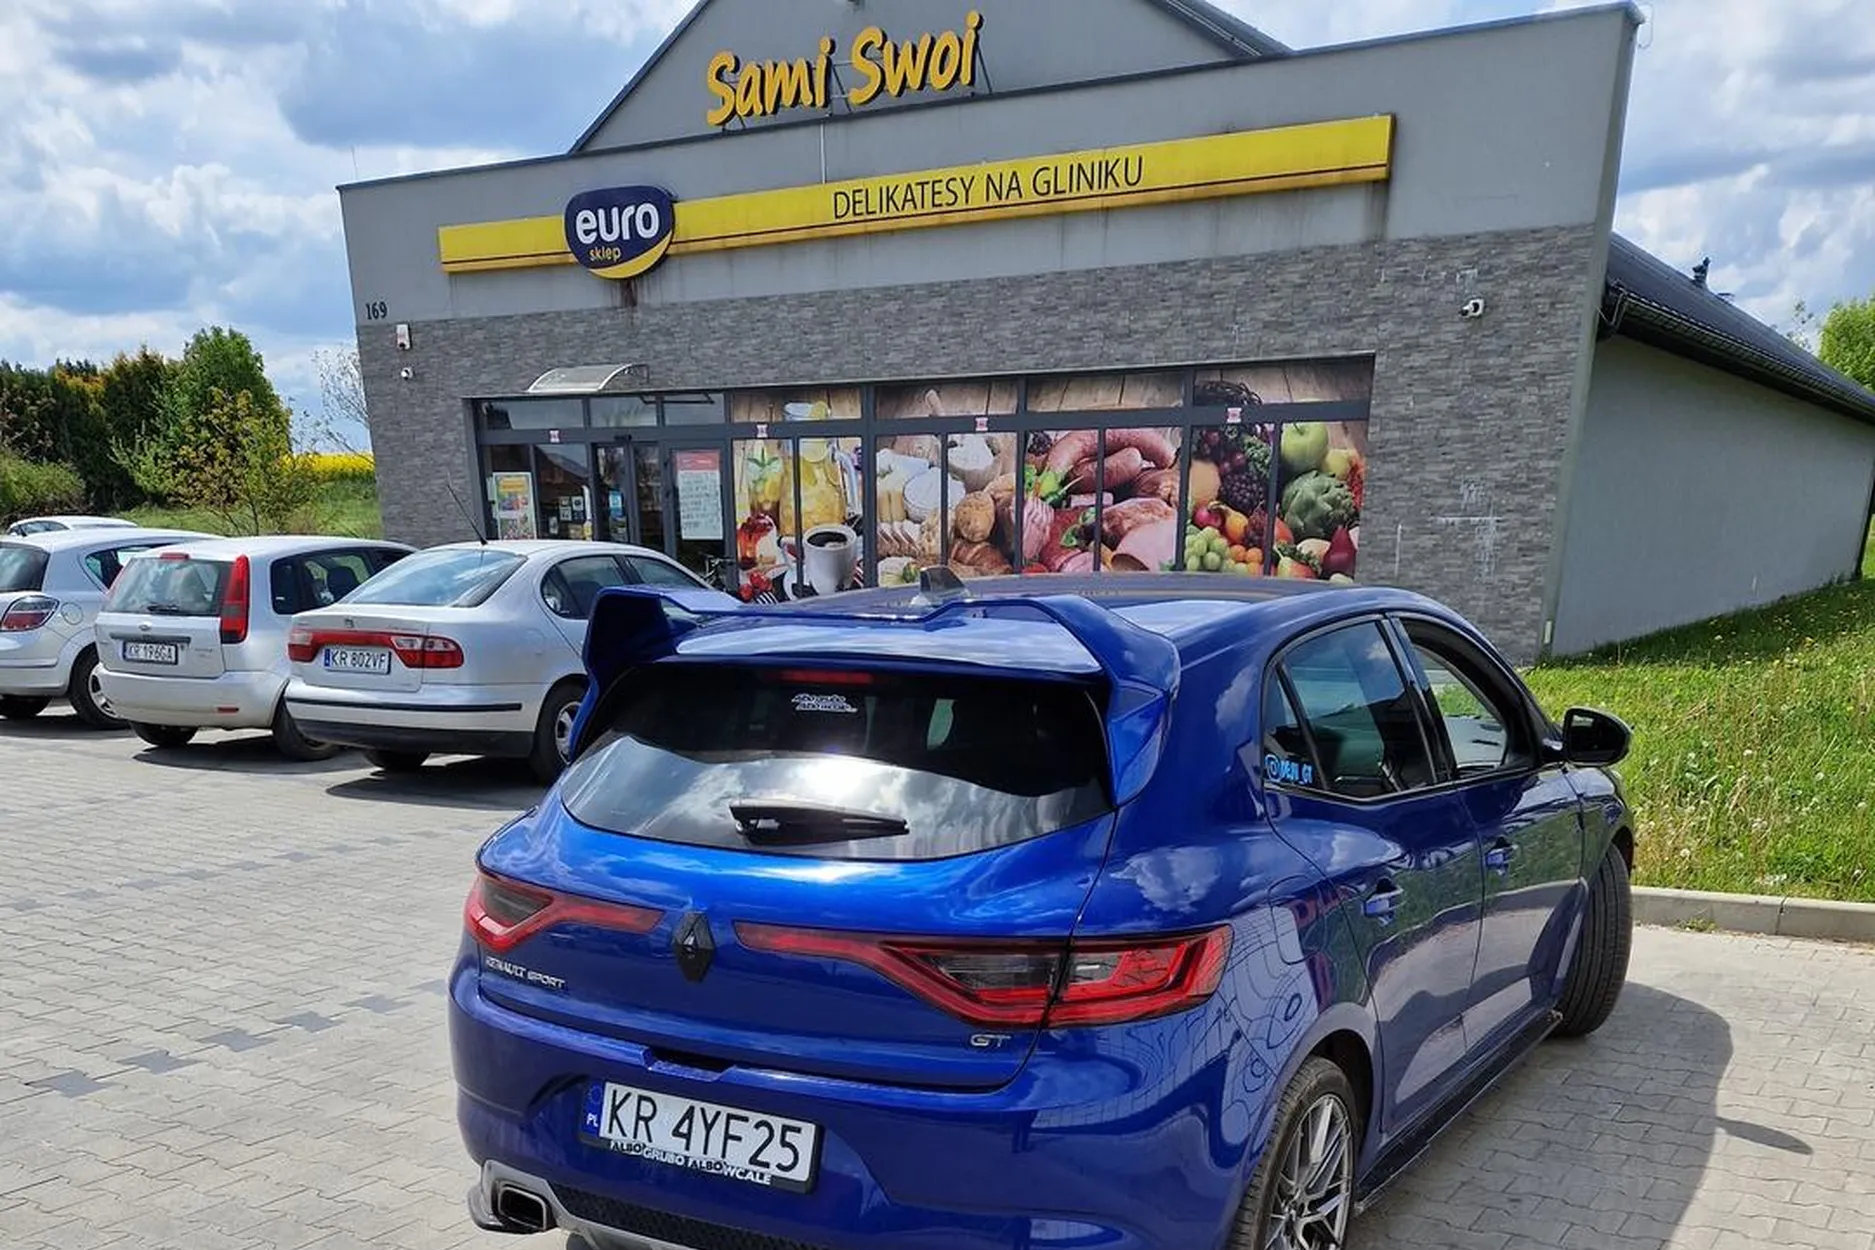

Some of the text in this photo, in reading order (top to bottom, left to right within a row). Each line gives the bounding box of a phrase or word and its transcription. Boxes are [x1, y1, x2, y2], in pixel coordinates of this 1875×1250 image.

[706, 10, 984, 126] Sami Swoi
[833, 155, 1144, 219] DELIKATESY NA GLINIKU
[575, 202, 660, 245] euro
[589, 246, 622, 262] sklep
[365, 301, 388, 320] 169
[331, 650, 348, 667] KR
[970, 1033, 1012, 1048] GT
[586, 1113, 599, 1127] PL
[608, 1089, 802, 1172] KR 4YF25
[723, 1164, 772, 1185] WCALE
